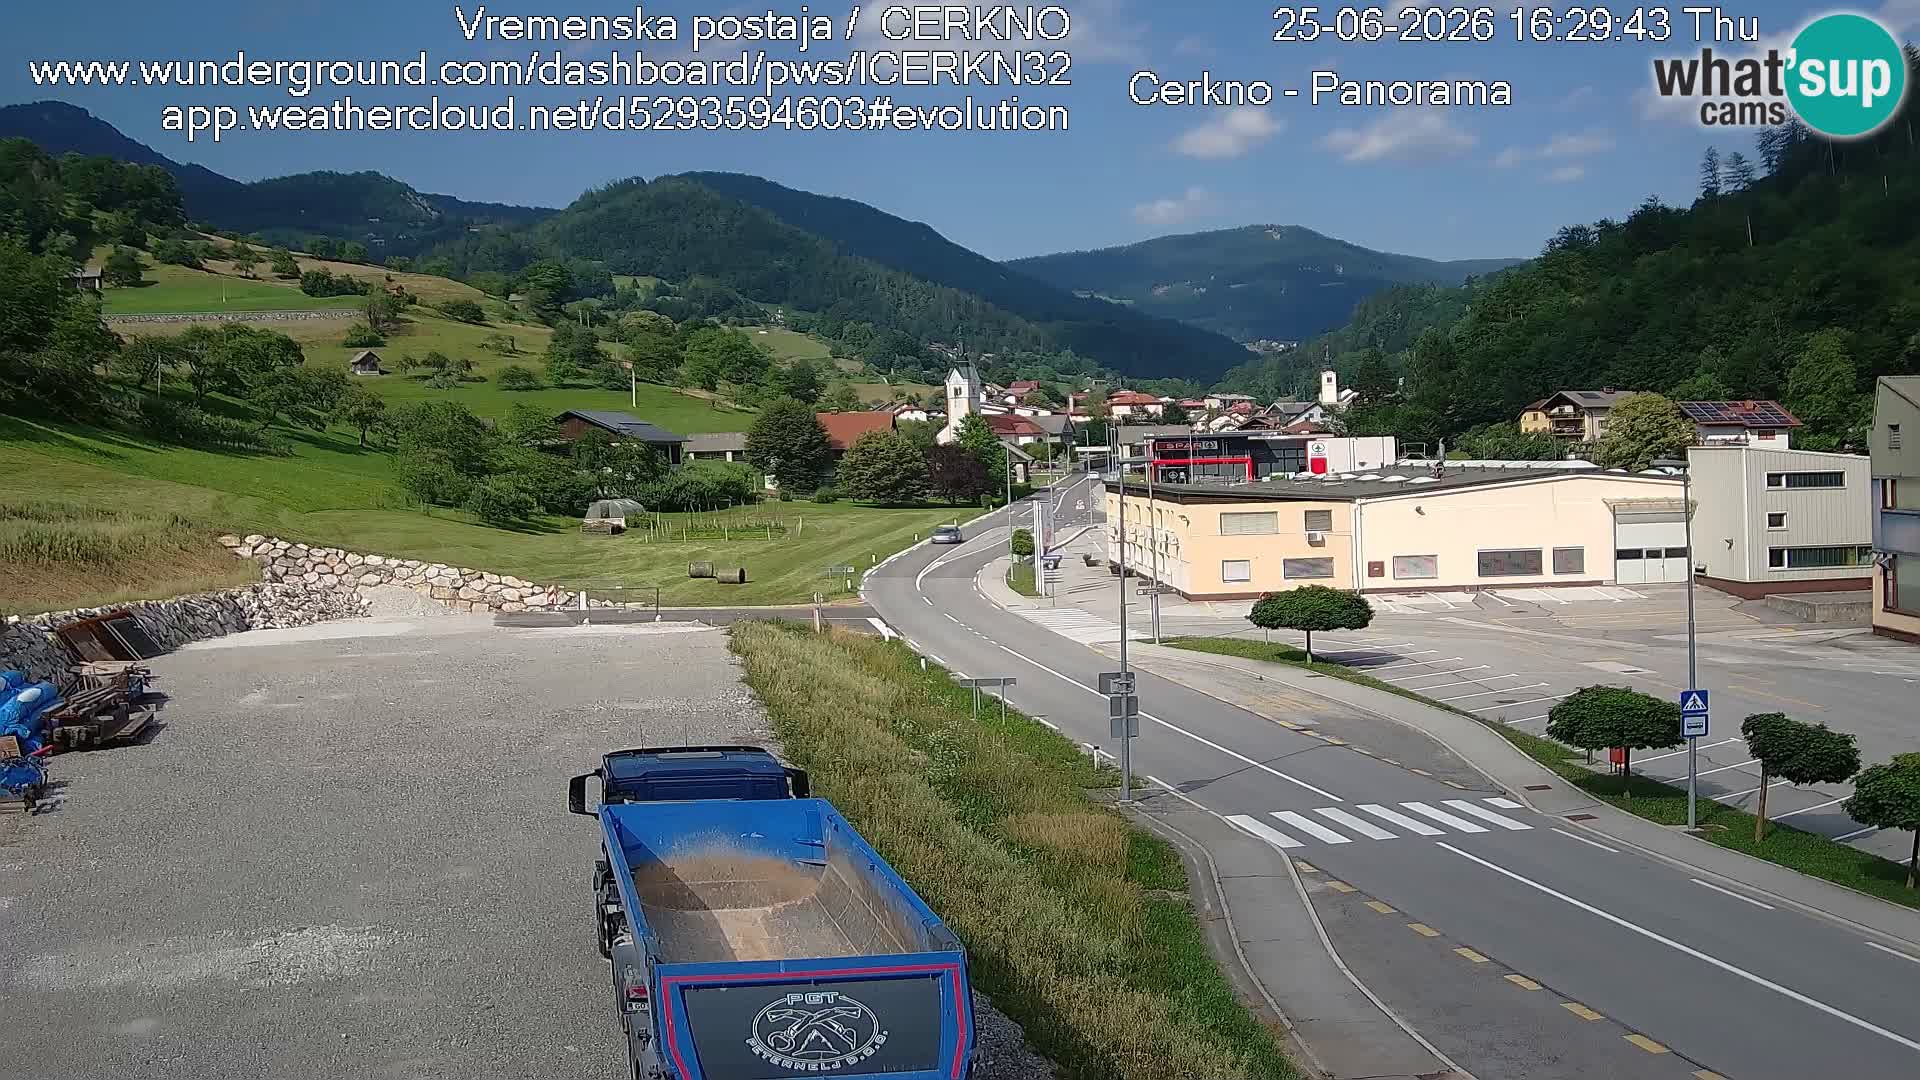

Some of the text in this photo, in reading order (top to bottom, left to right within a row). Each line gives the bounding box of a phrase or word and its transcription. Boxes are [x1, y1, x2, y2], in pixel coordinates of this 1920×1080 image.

[1166, 442, 1202, 450] SPAR
[787, 991, 839, 1005] PGT
[745, 1037, 841, 1071] PETERNELJ
